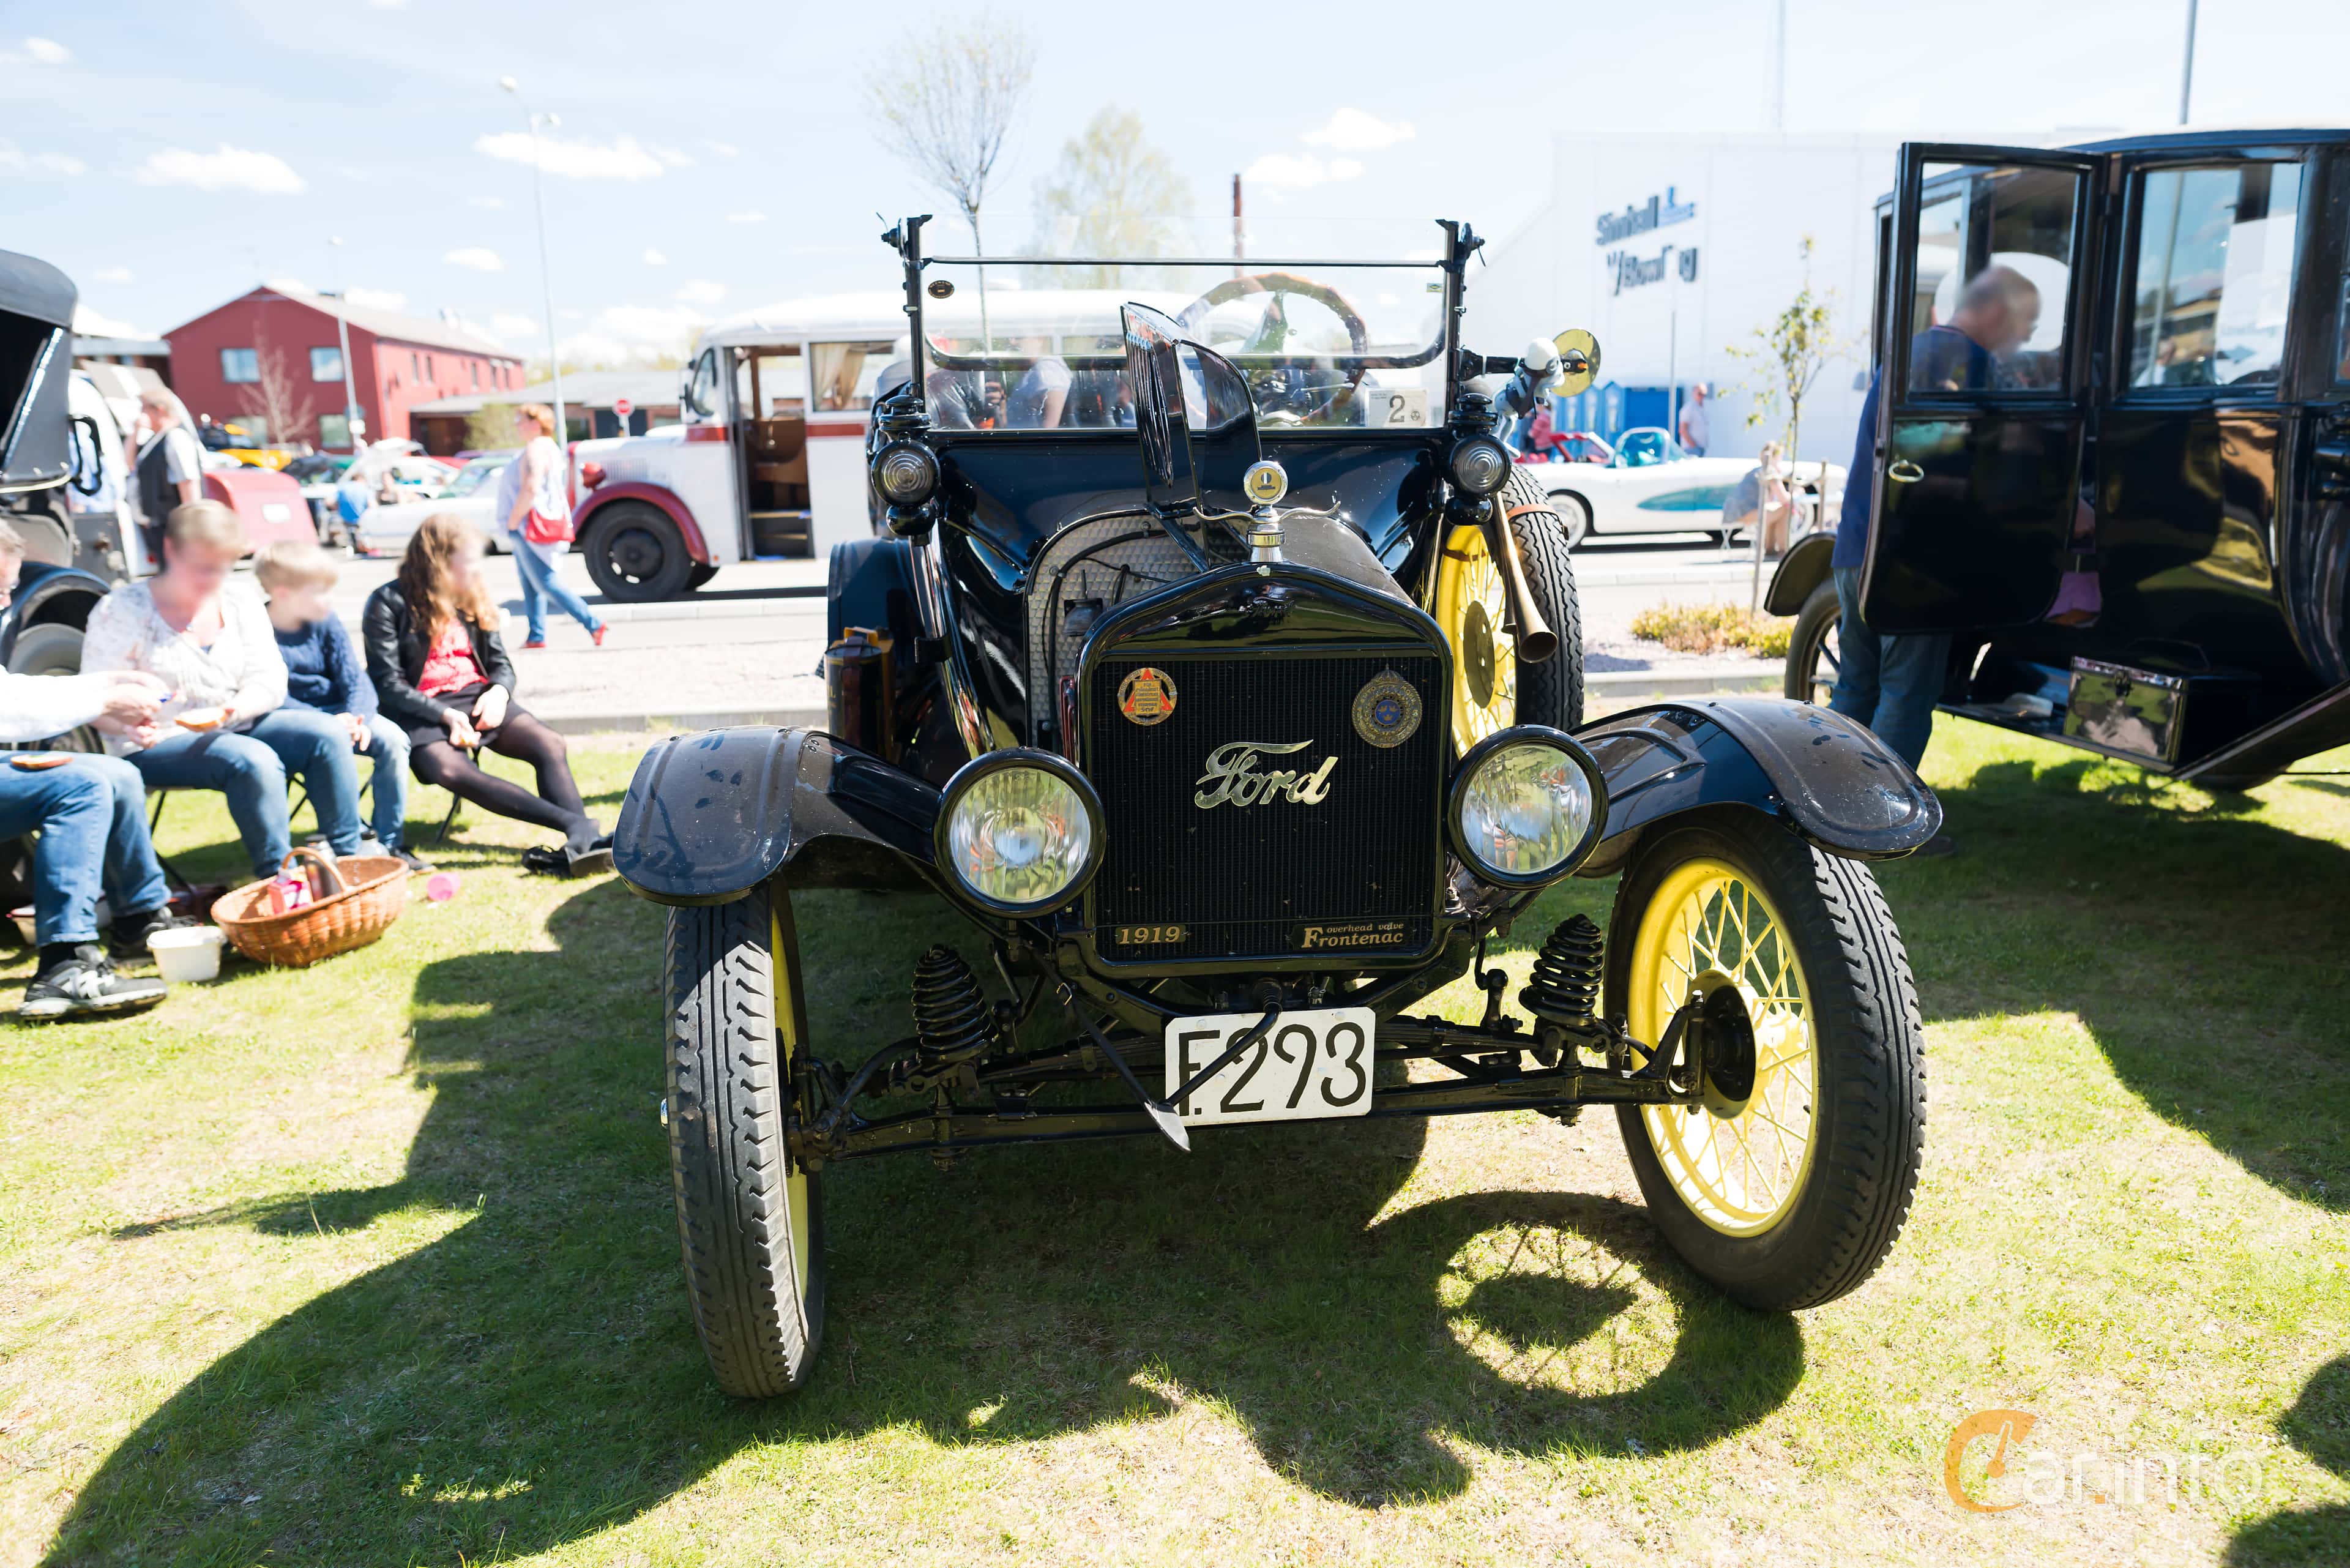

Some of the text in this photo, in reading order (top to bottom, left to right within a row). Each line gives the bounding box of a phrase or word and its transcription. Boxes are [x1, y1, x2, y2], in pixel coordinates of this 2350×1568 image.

[1389, 395, 1405, 422] 2
[1195, 739, 1338, 808] Ford
[1119, 926, 1181, 944] 1919
[1301, 927, 1404, 948] Frontenac
[1327, 922, 1404, 934] overhead valve
